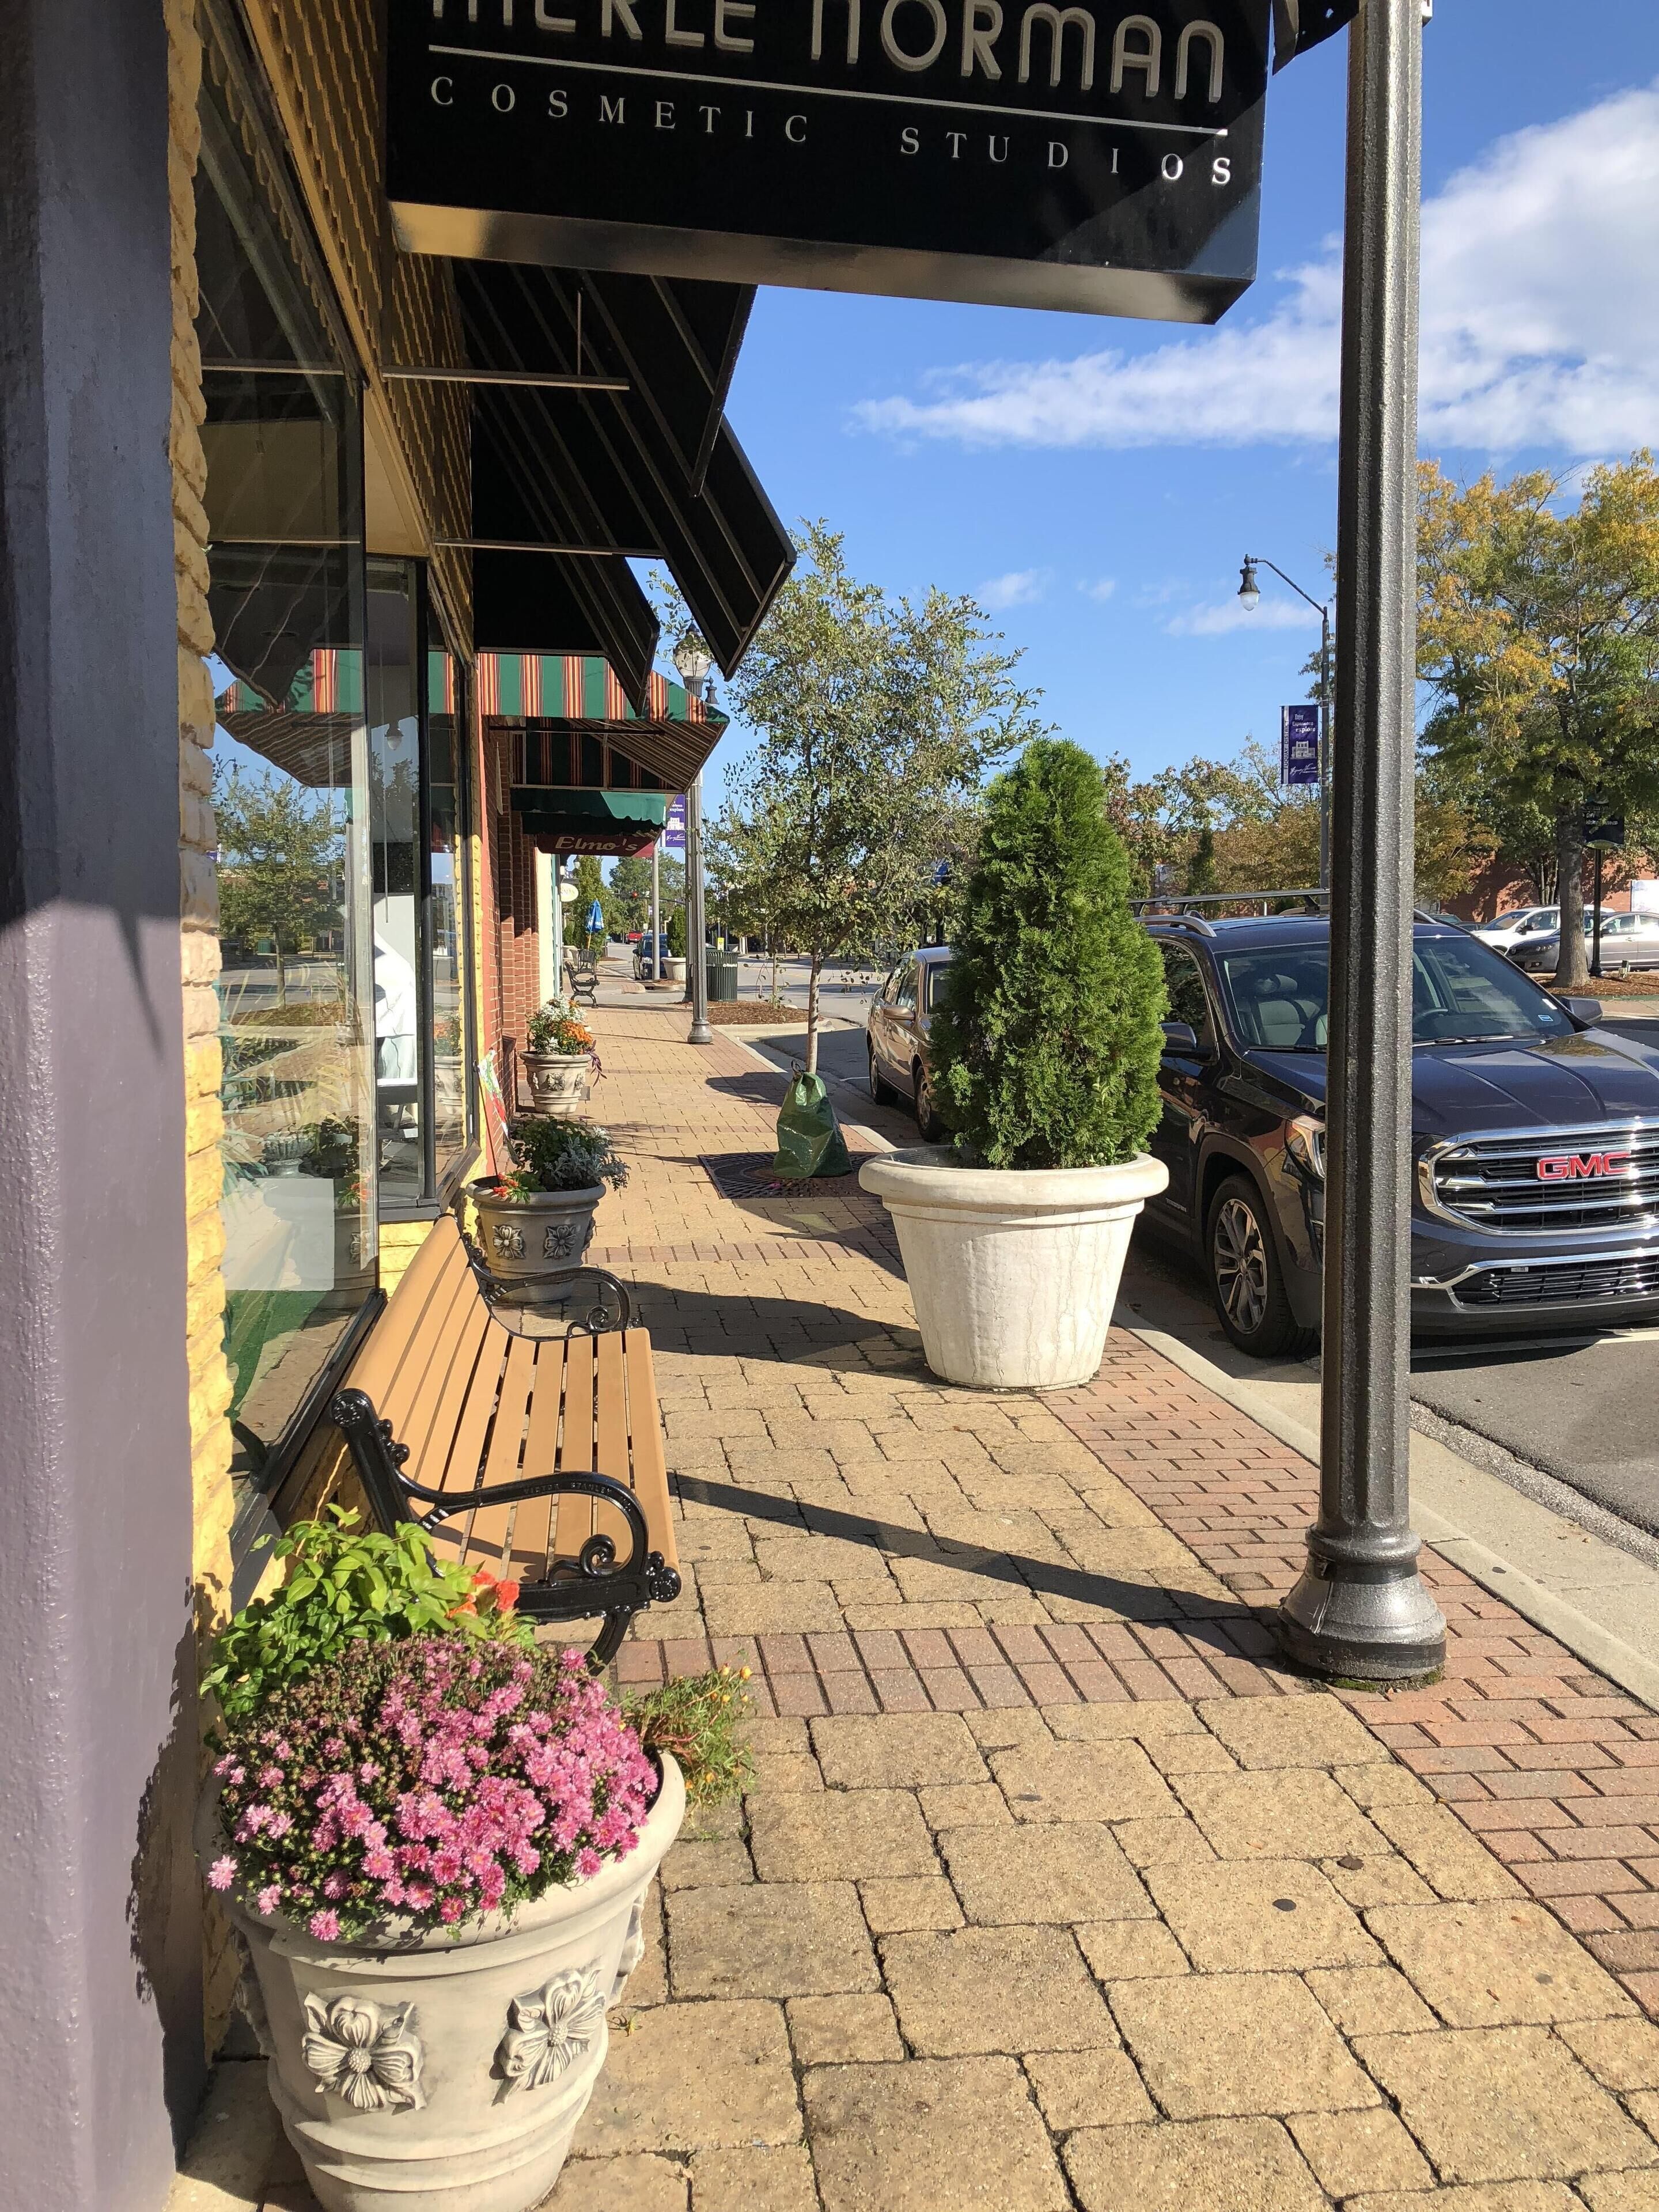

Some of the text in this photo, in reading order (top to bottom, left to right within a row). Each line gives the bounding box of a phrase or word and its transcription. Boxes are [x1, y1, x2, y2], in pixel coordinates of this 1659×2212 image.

[433, 0, 1225, 103] RLE NORMAN
[431, 77, 1232, 186] COSMETIC STUDIOS
[555, 836, 638, 851] Elmo's
[1537, 1151, 1631, 1180] GMC
